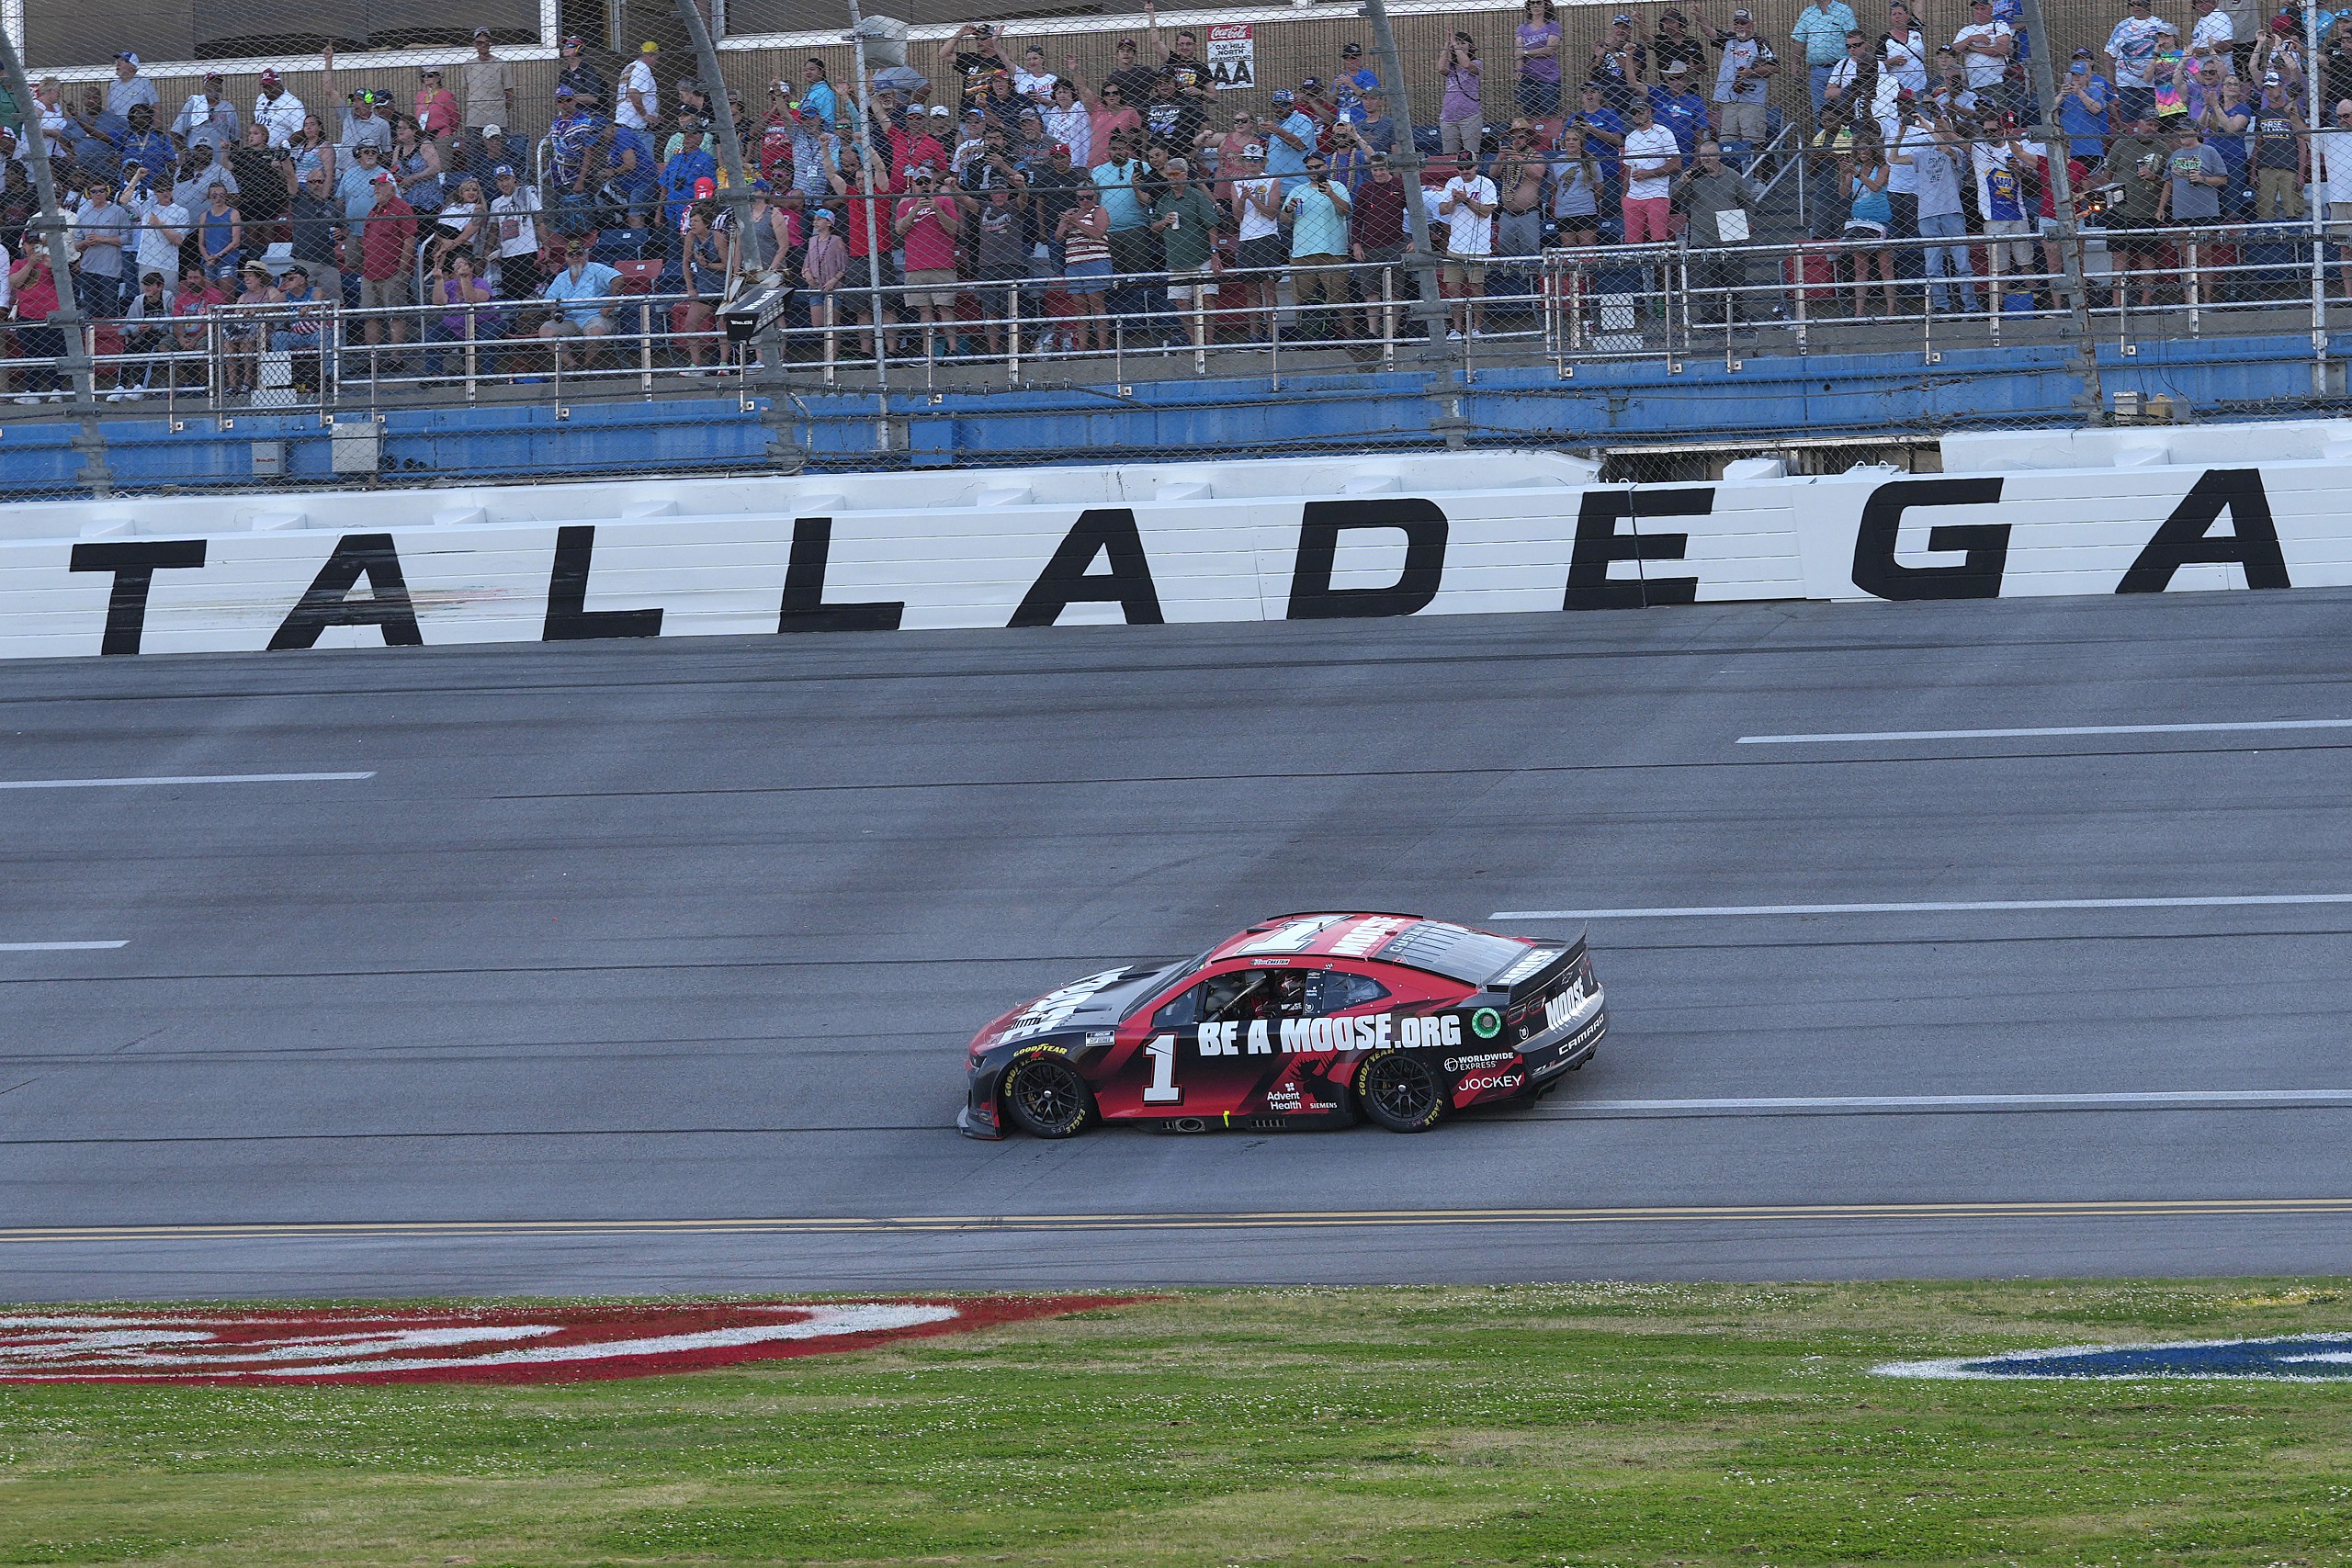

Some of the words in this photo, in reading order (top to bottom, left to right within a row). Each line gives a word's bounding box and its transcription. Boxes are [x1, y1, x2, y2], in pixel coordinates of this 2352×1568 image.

[69, 468, 2291, 656] TALLADEGA
[1544, 976, 1588, 1031] MOOSE
[1198, 1021, 1239, 1056] BE
[1247, 1019, 1272, 1055] A
[1280, 1012, 1462, 1054] MOOSE.ORG
[1558, 1013, 1605, 1055] CAMARO
[1013, 1043, 1069, 1057] GOODYEAR
[1458, 1052, 1514, 1064] WORLDWIDE
[1143, 1034, 1182, 1102] 1
[1460, 1060, 1497, 1071] EXPRESS
[1458, 1074, 1522, 1091] JOCKEY
[1267, 1091, 1301, 1101] Advent
[1271, 1101, 1303, 1111] Health
[1066, 1108, 1086, 1134] EAGLE
[1423, 1098, 1443, 1126] EAGLE
